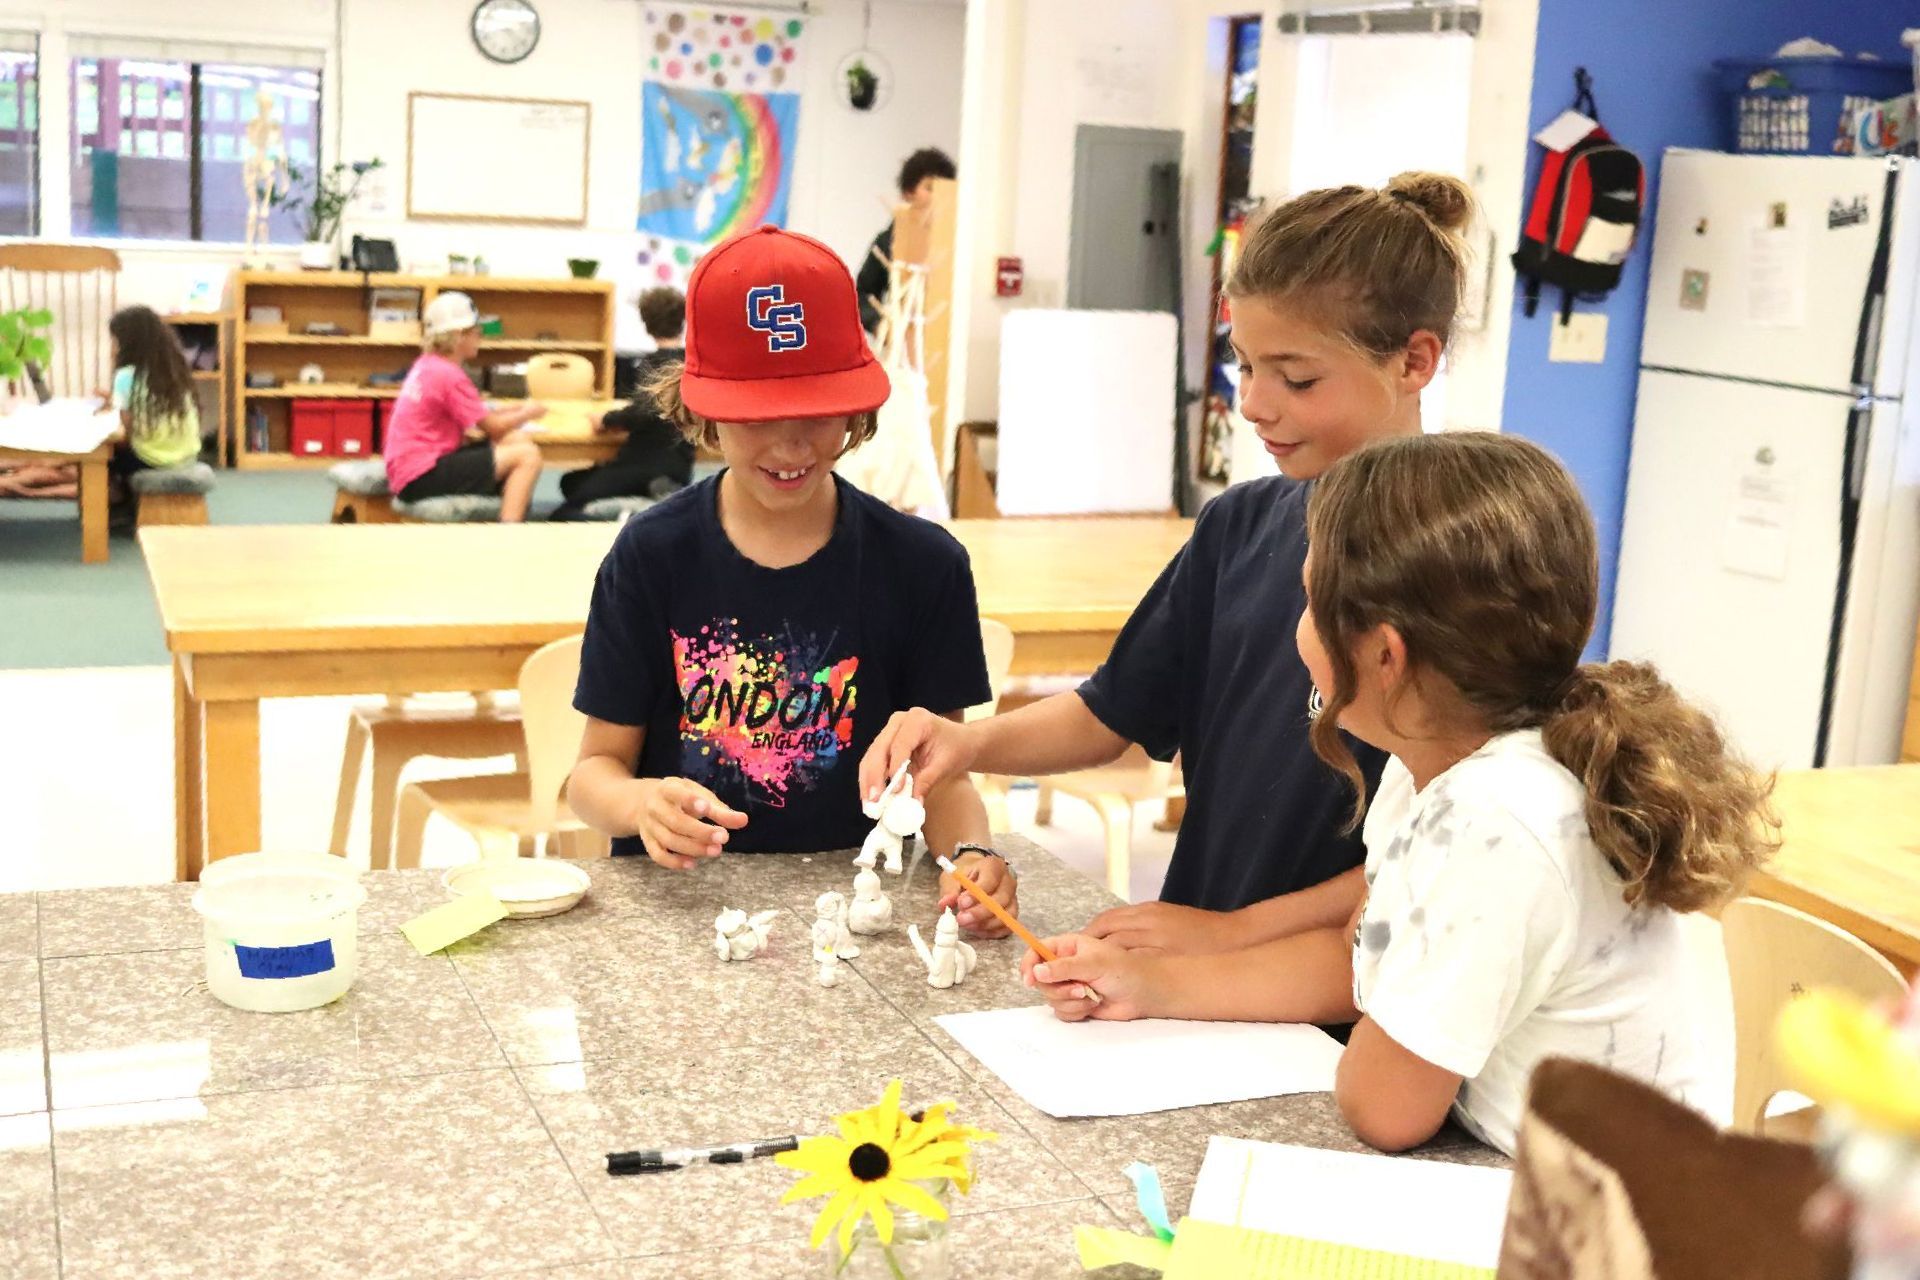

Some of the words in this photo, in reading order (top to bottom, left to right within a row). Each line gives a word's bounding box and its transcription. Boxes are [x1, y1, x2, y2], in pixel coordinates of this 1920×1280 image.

[746, 285, 807, 352] CS
[686, 674, 856, 730] ONDON
[752, 731, 834, 750] ENGLAND
